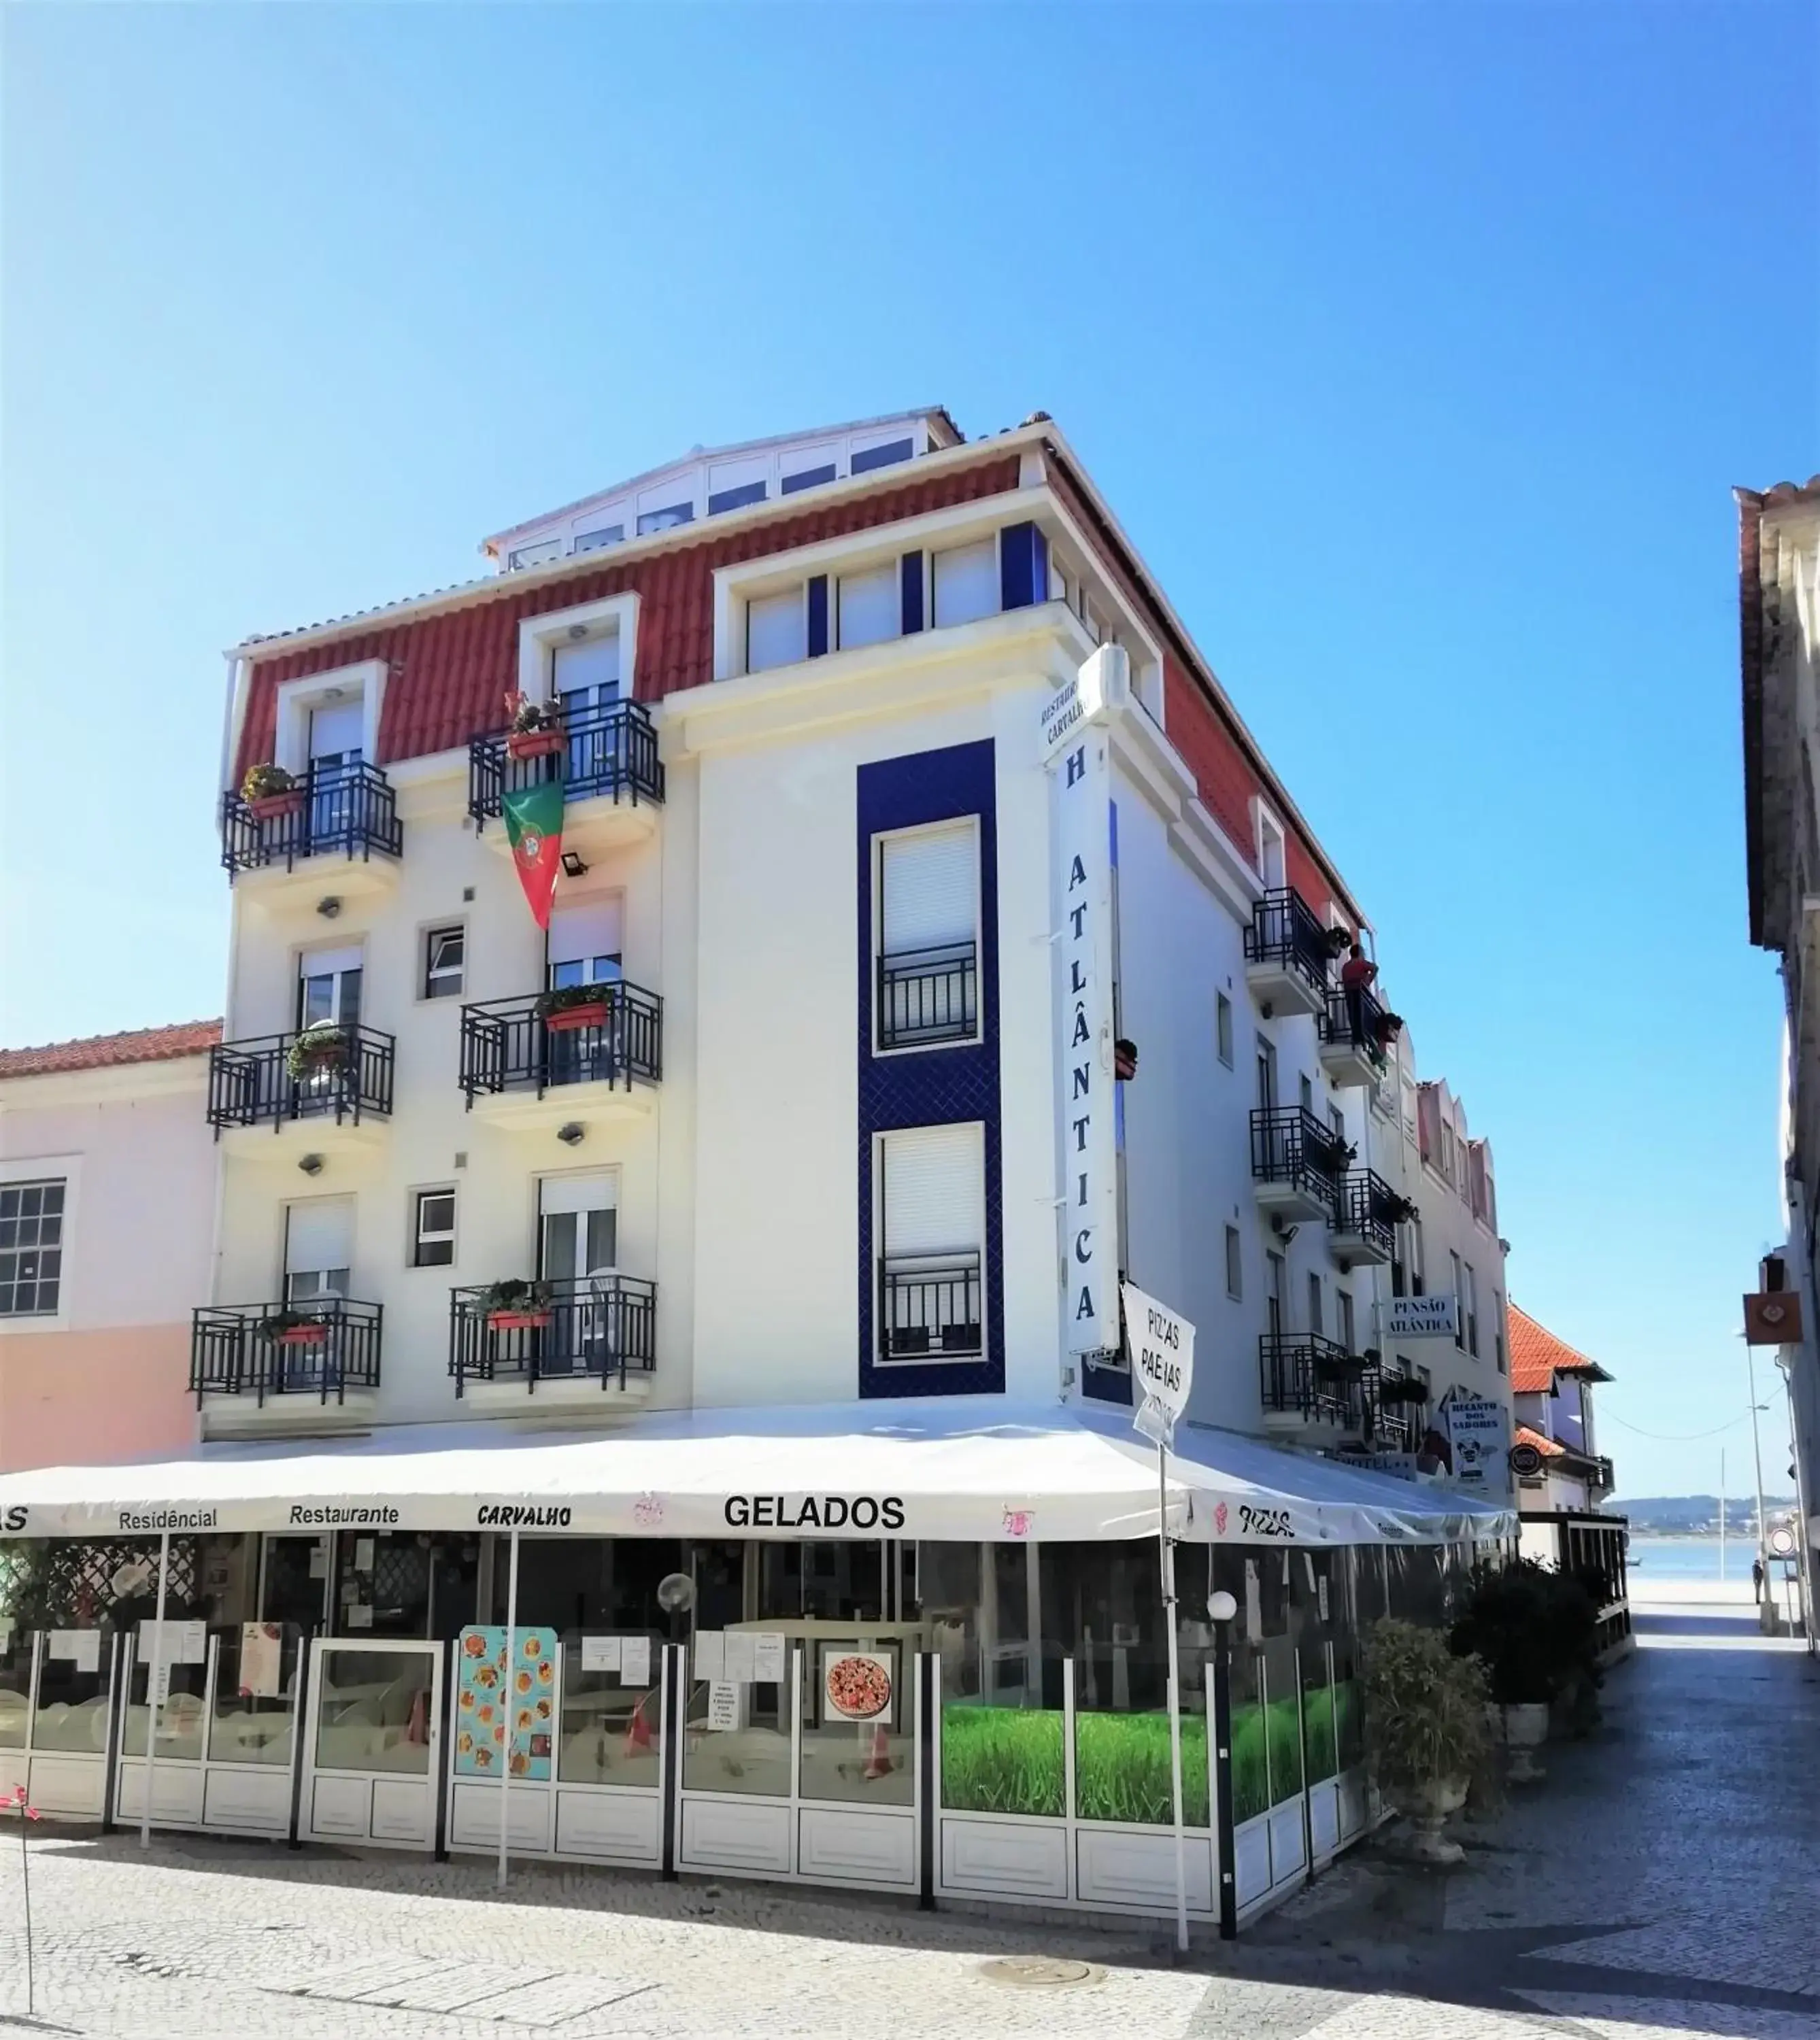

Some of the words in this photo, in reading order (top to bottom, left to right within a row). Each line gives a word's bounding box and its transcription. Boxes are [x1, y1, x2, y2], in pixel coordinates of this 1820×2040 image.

[1068, 853, 1094, 1321] ATLÂNTICA
[119, 1508, 217, 1529] Residêncial
[290, 1505, 399, 1524] Restaurante
[477, 1505, 571, 1527] CARVALHO
[724, 1496, 905, 1529] GELADOS
